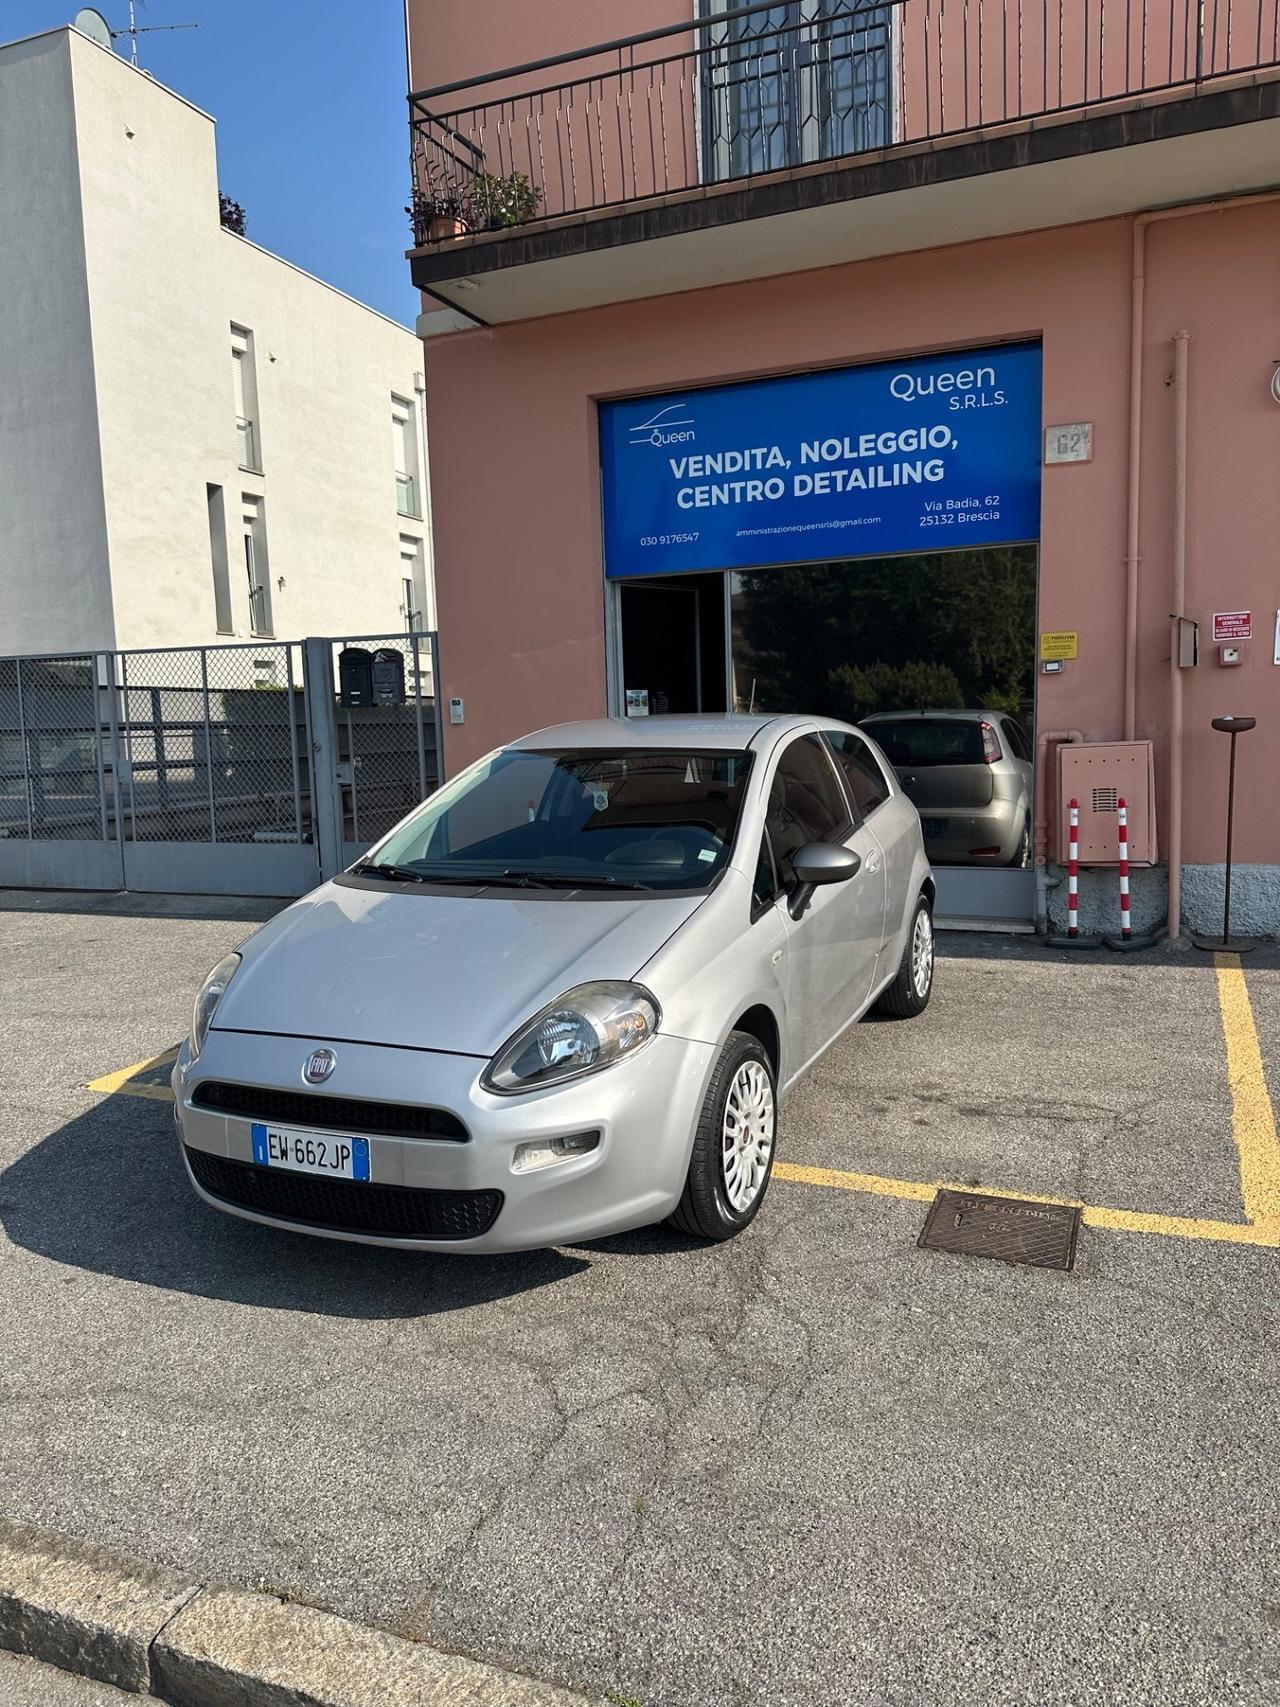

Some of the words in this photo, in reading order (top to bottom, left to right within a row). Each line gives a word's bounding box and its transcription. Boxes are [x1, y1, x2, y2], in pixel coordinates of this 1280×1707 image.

[890, 367, 995, 402] Queen
[949, 390, 1008, 410] S.R.L.S.
[650, 430, 695, 447] Queen
[669, 446, 792, 479] VENDITA,
[800, 425, 958, 465] NOLEGGIO,
[677, 477, 785, 509] CENTRO
[794, 459, 945, 497] DETAILING
[924, 501, 942, 512] Via
[946, 498, 982, 510] Badia,
[985, 496, 1000, 506] 62
[736, 516, 881, 537] amministrazionequeensrls@gmail.com
[920, 513, 954, 527] 25132
[958, 509, 1000, 523] Brescia
[640, 537, 657, 546] 030
[660, 532, 700, 544] 9176547
[311, 1057, 330, 1073] FIAT
